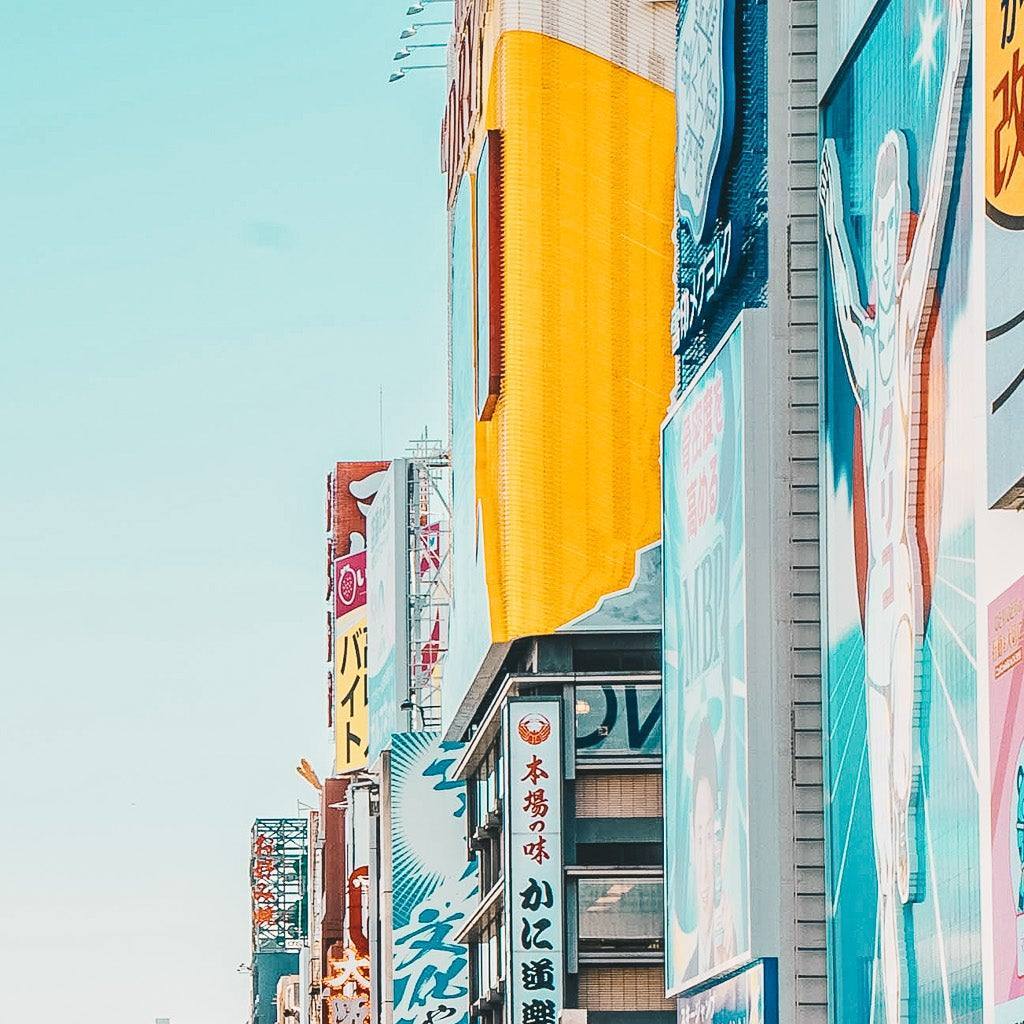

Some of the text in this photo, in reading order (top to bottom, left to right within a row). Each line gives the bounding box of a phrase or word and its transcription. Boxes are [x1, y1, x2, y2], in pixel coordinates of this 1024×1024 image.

[340, 628, 362, 764] バイト
[521, 754, 550, 866] 本場の味
